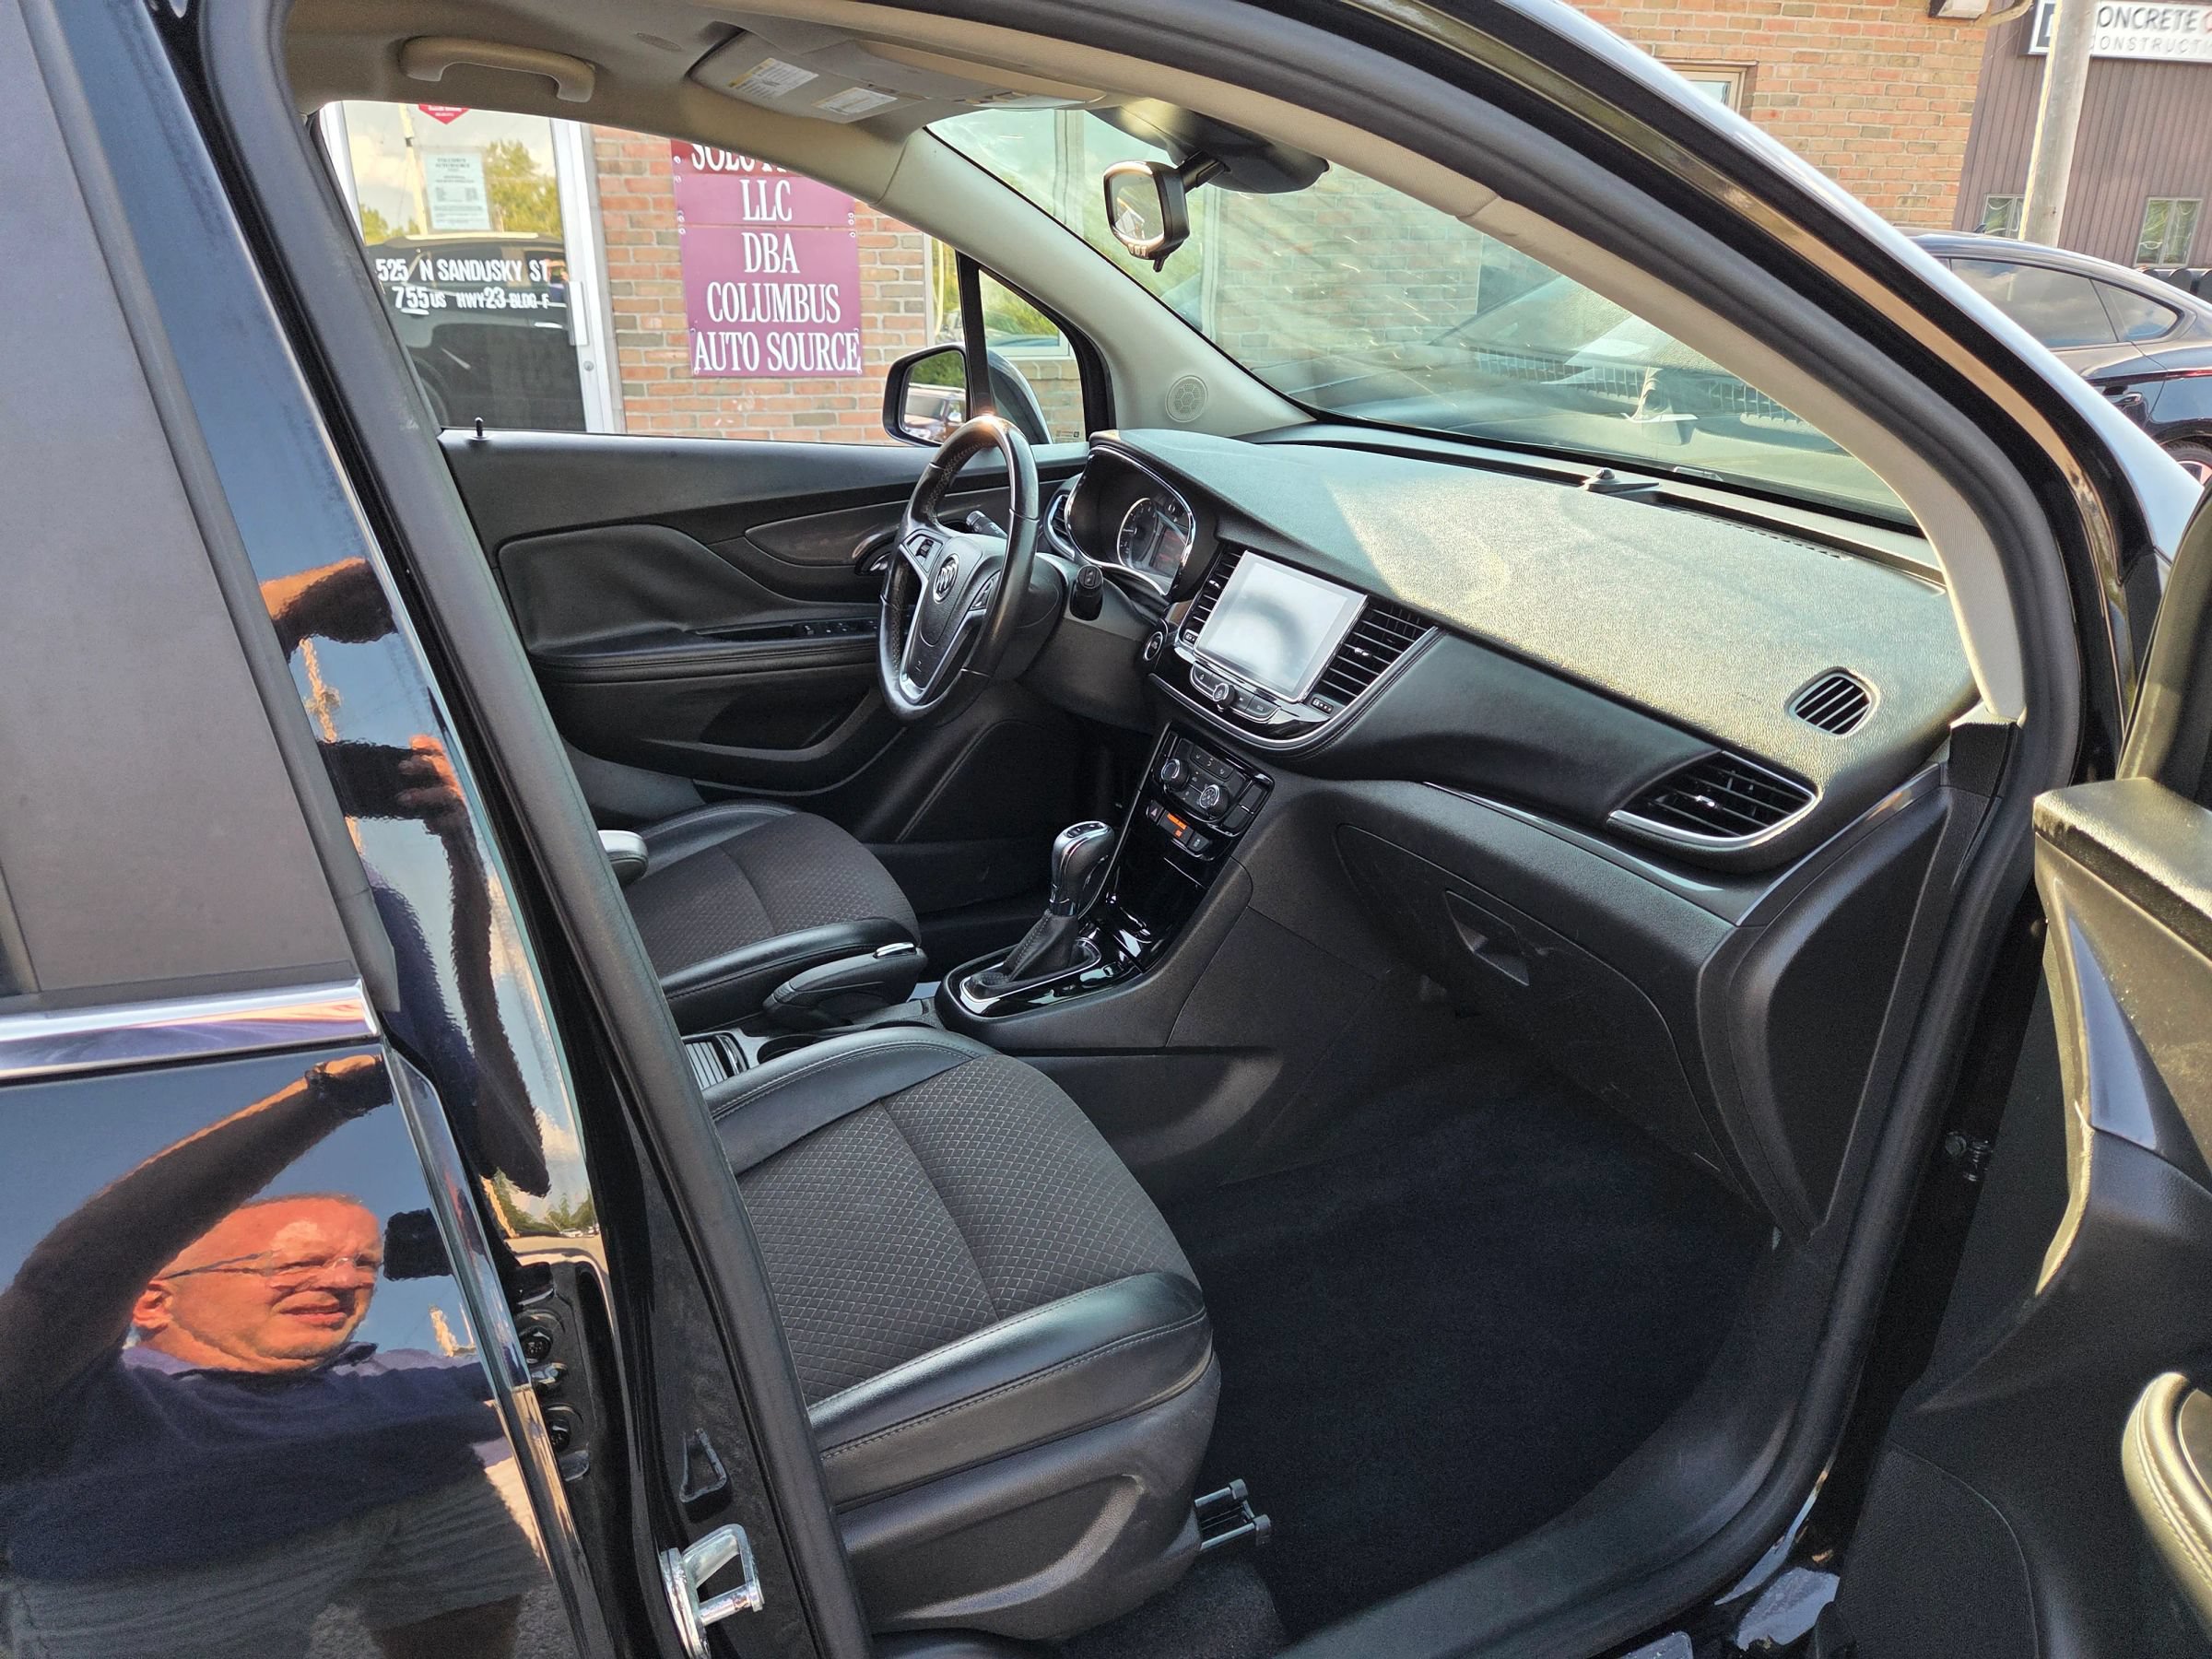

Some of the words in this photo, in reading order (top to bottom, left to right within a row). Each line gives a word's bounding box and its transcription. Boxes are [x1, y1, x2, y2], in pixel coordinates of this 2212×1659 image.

[2098, 6, 2200, 31] ONCRETE
[739, 179, 793, 221] LLC
[375, 258, 408, 282] 525
[419, 259, 434, 282] N
[438, 259, 523, 283] SANDUSKY
[529, 259, 549, 283] ST
[741, 232, 800, 273] DBA
[707, 281, 841, 324] COLUMBUS
[694, 331, 759, 371] AUTO
[766, 332, 861, 372] SOURCE
